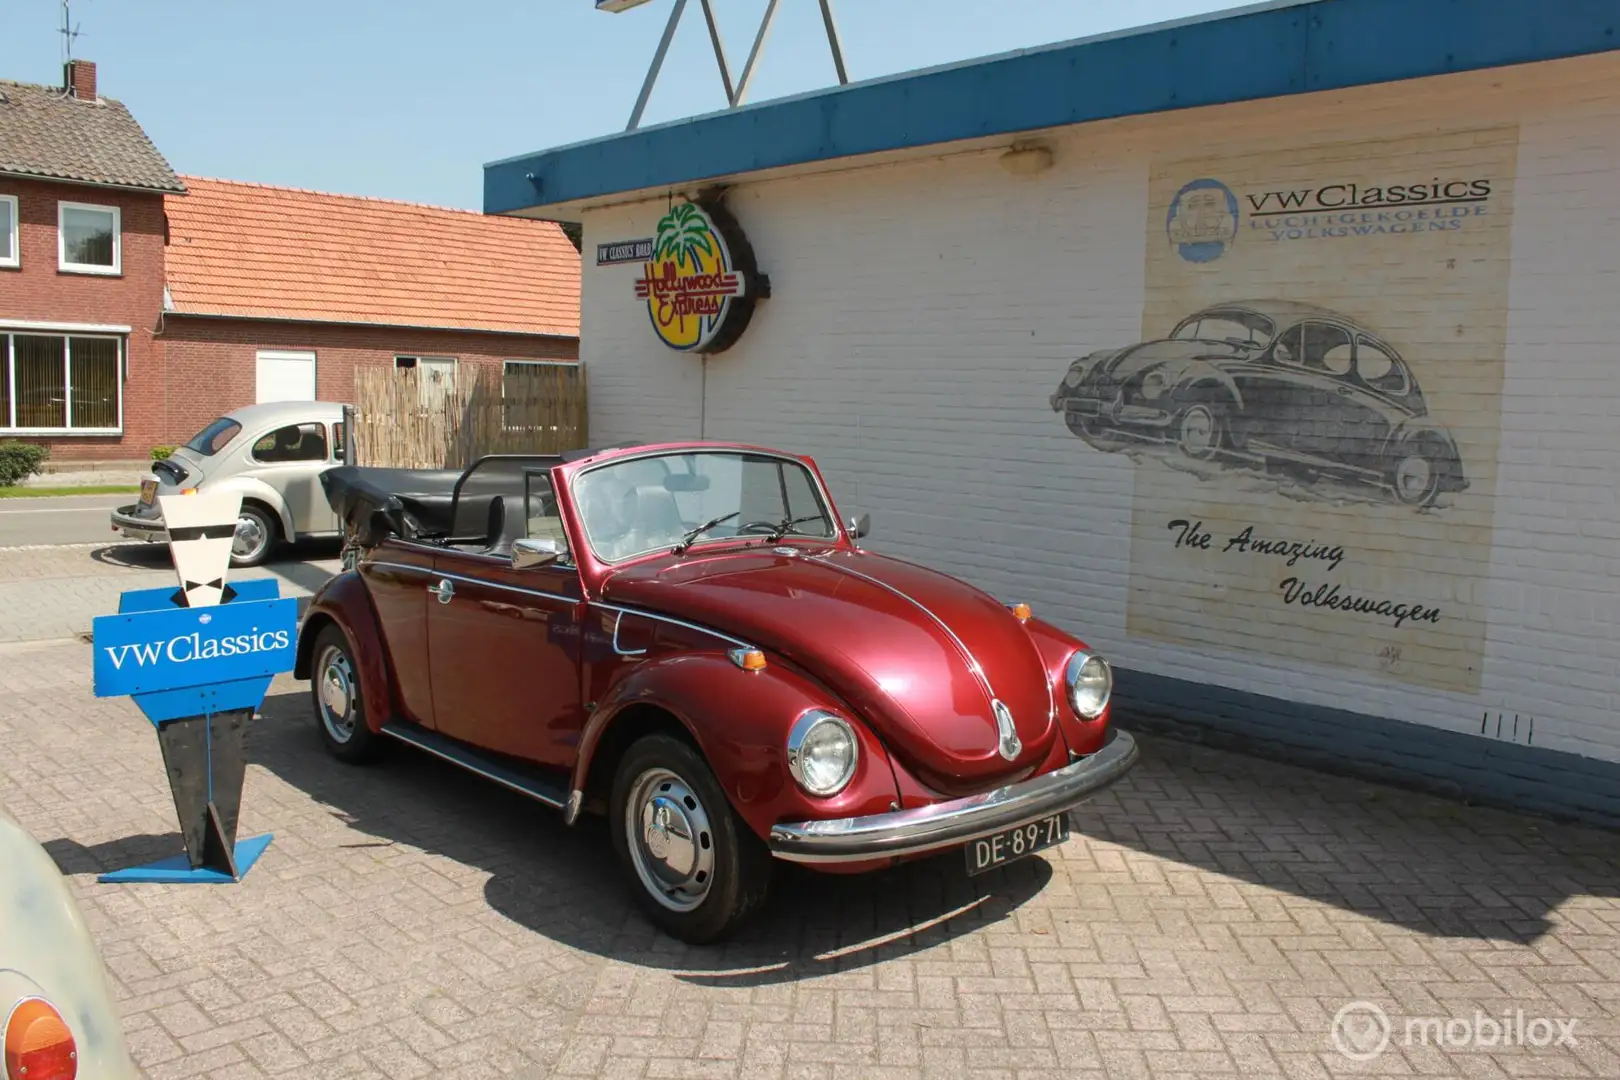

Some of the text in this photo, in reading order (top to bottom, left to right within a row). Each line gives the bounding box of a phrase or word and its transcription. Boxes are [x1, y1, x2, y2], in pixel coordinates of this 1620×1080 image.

[1271, 219, 1462, 242] VOLKSWAGENS
[644, 258, 722, 298] Hollywood
[658, 295, 719, 334] Express
[1168, 519, 1345, 571] The Amazing
[1280, 576, 1441, 628] Volkswagen
[975, 815, 1061, 868] DE-89-71
